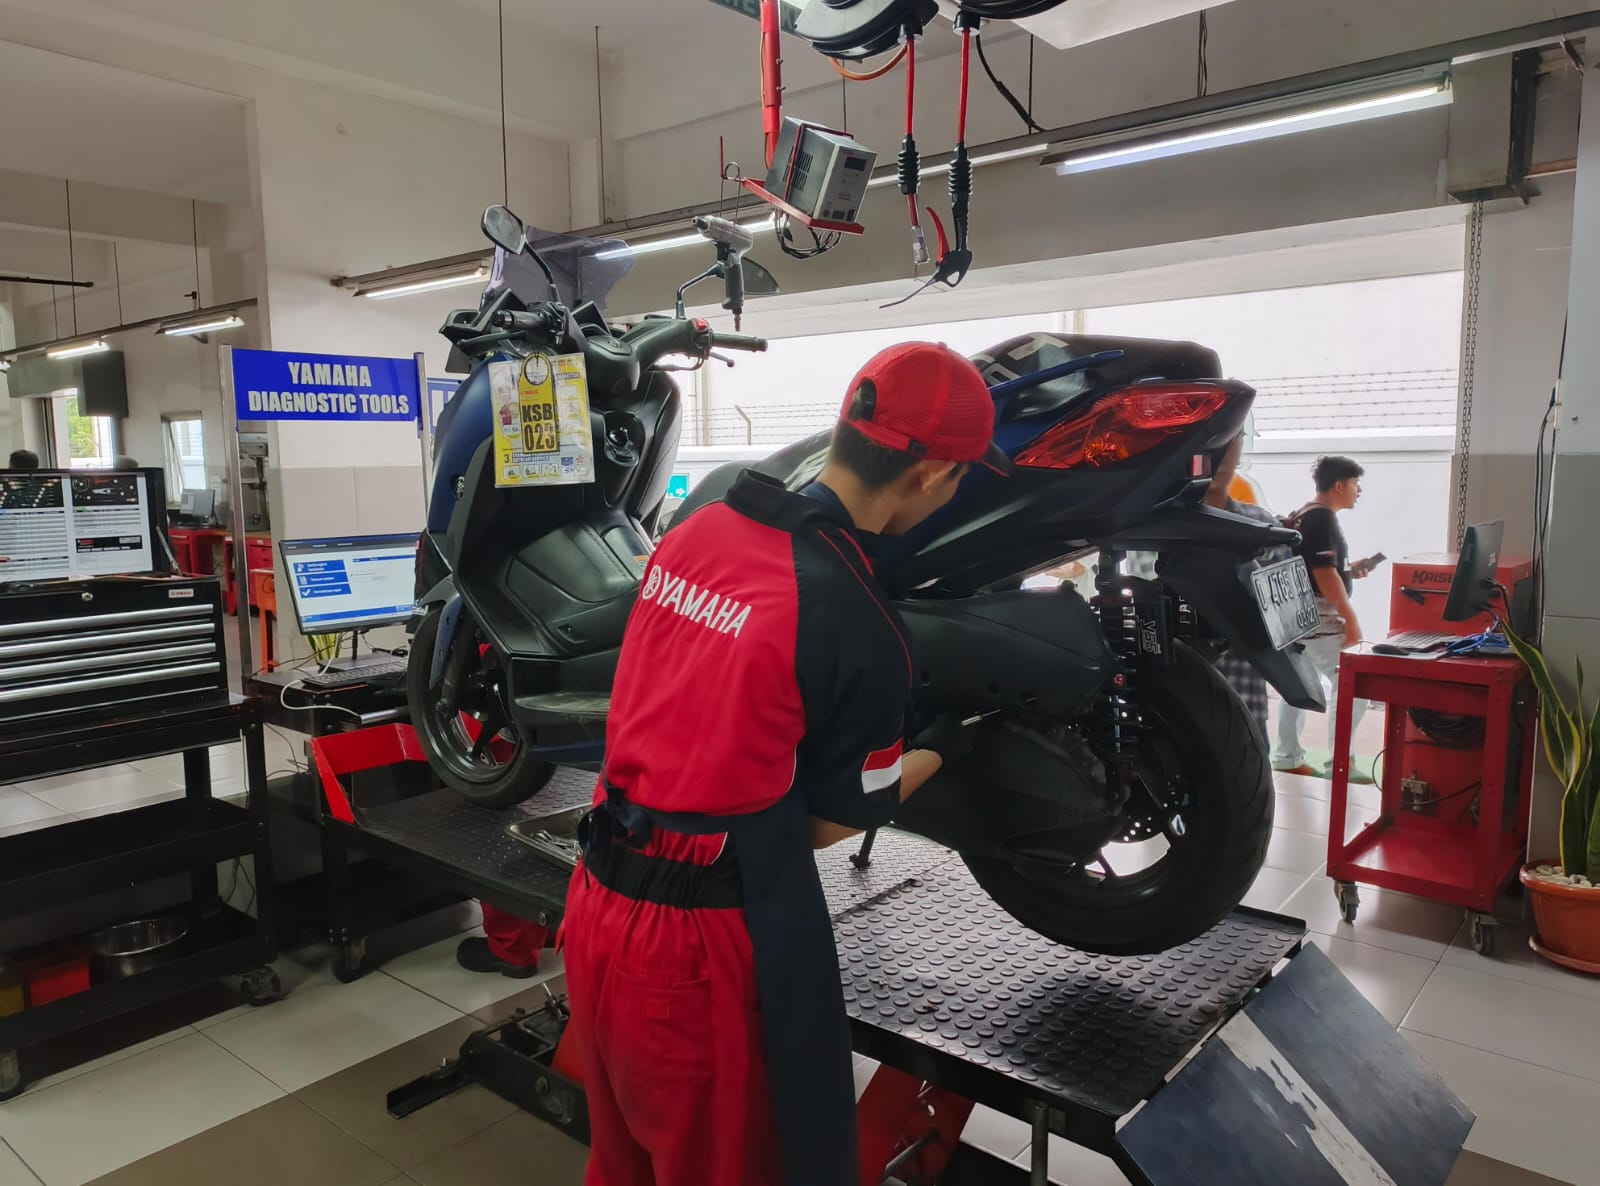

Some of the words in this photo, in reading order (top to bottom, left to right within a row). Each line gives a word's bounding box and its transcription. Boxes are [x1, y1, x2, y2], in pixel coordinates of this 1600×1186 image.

[287, 361, 372, 387] YAMAHA
[247, 390, 357, 413] DIAGNOSTIC
[359, 394, 410, 414] TOOLS
[521, 403, 553, 423] KSB
[523, 423, 555, 451] 023
[503, 454, 510, 463] 3
[656, 571, 752, 638] YAMAHA
